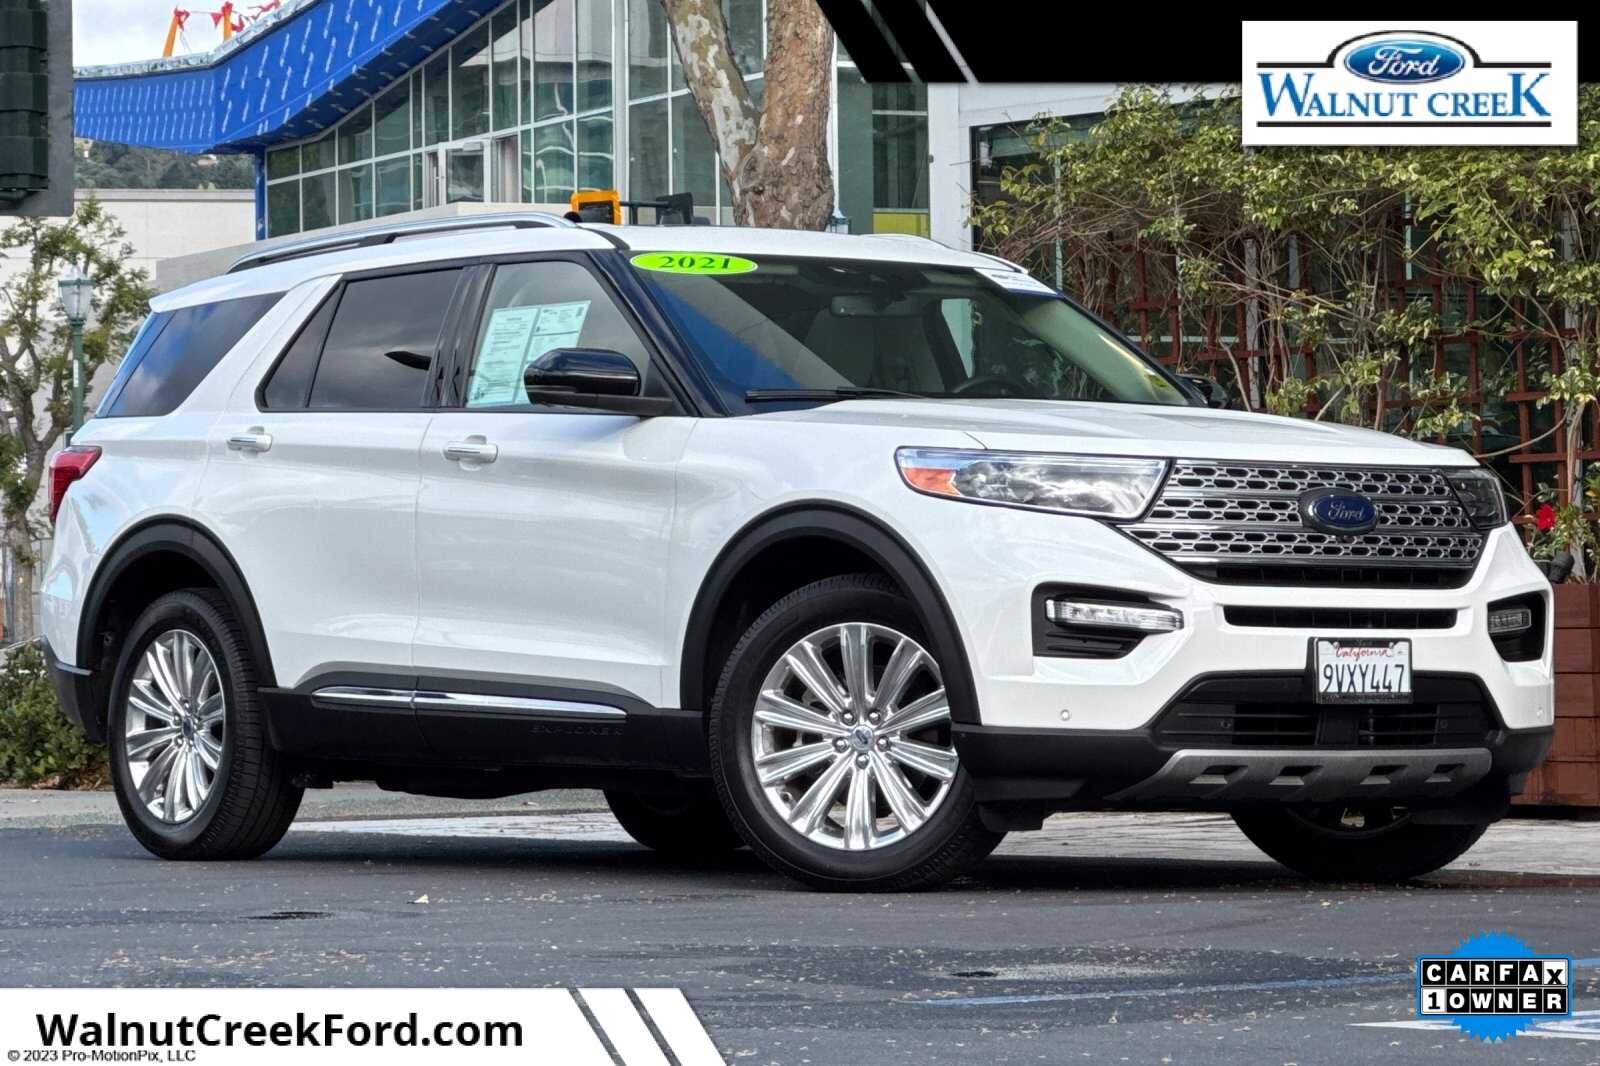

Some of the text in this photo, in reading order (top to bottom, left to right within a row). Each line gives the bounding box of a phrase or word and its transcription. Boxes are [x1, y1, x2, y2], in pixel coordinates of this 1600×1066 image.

[658, 255, 731, 269] 2021
[1328, 501, 1364, 520] Ford
[1336, 647, 1391, 661] California
[1323, 664, 1405, 693] 9VXY447
